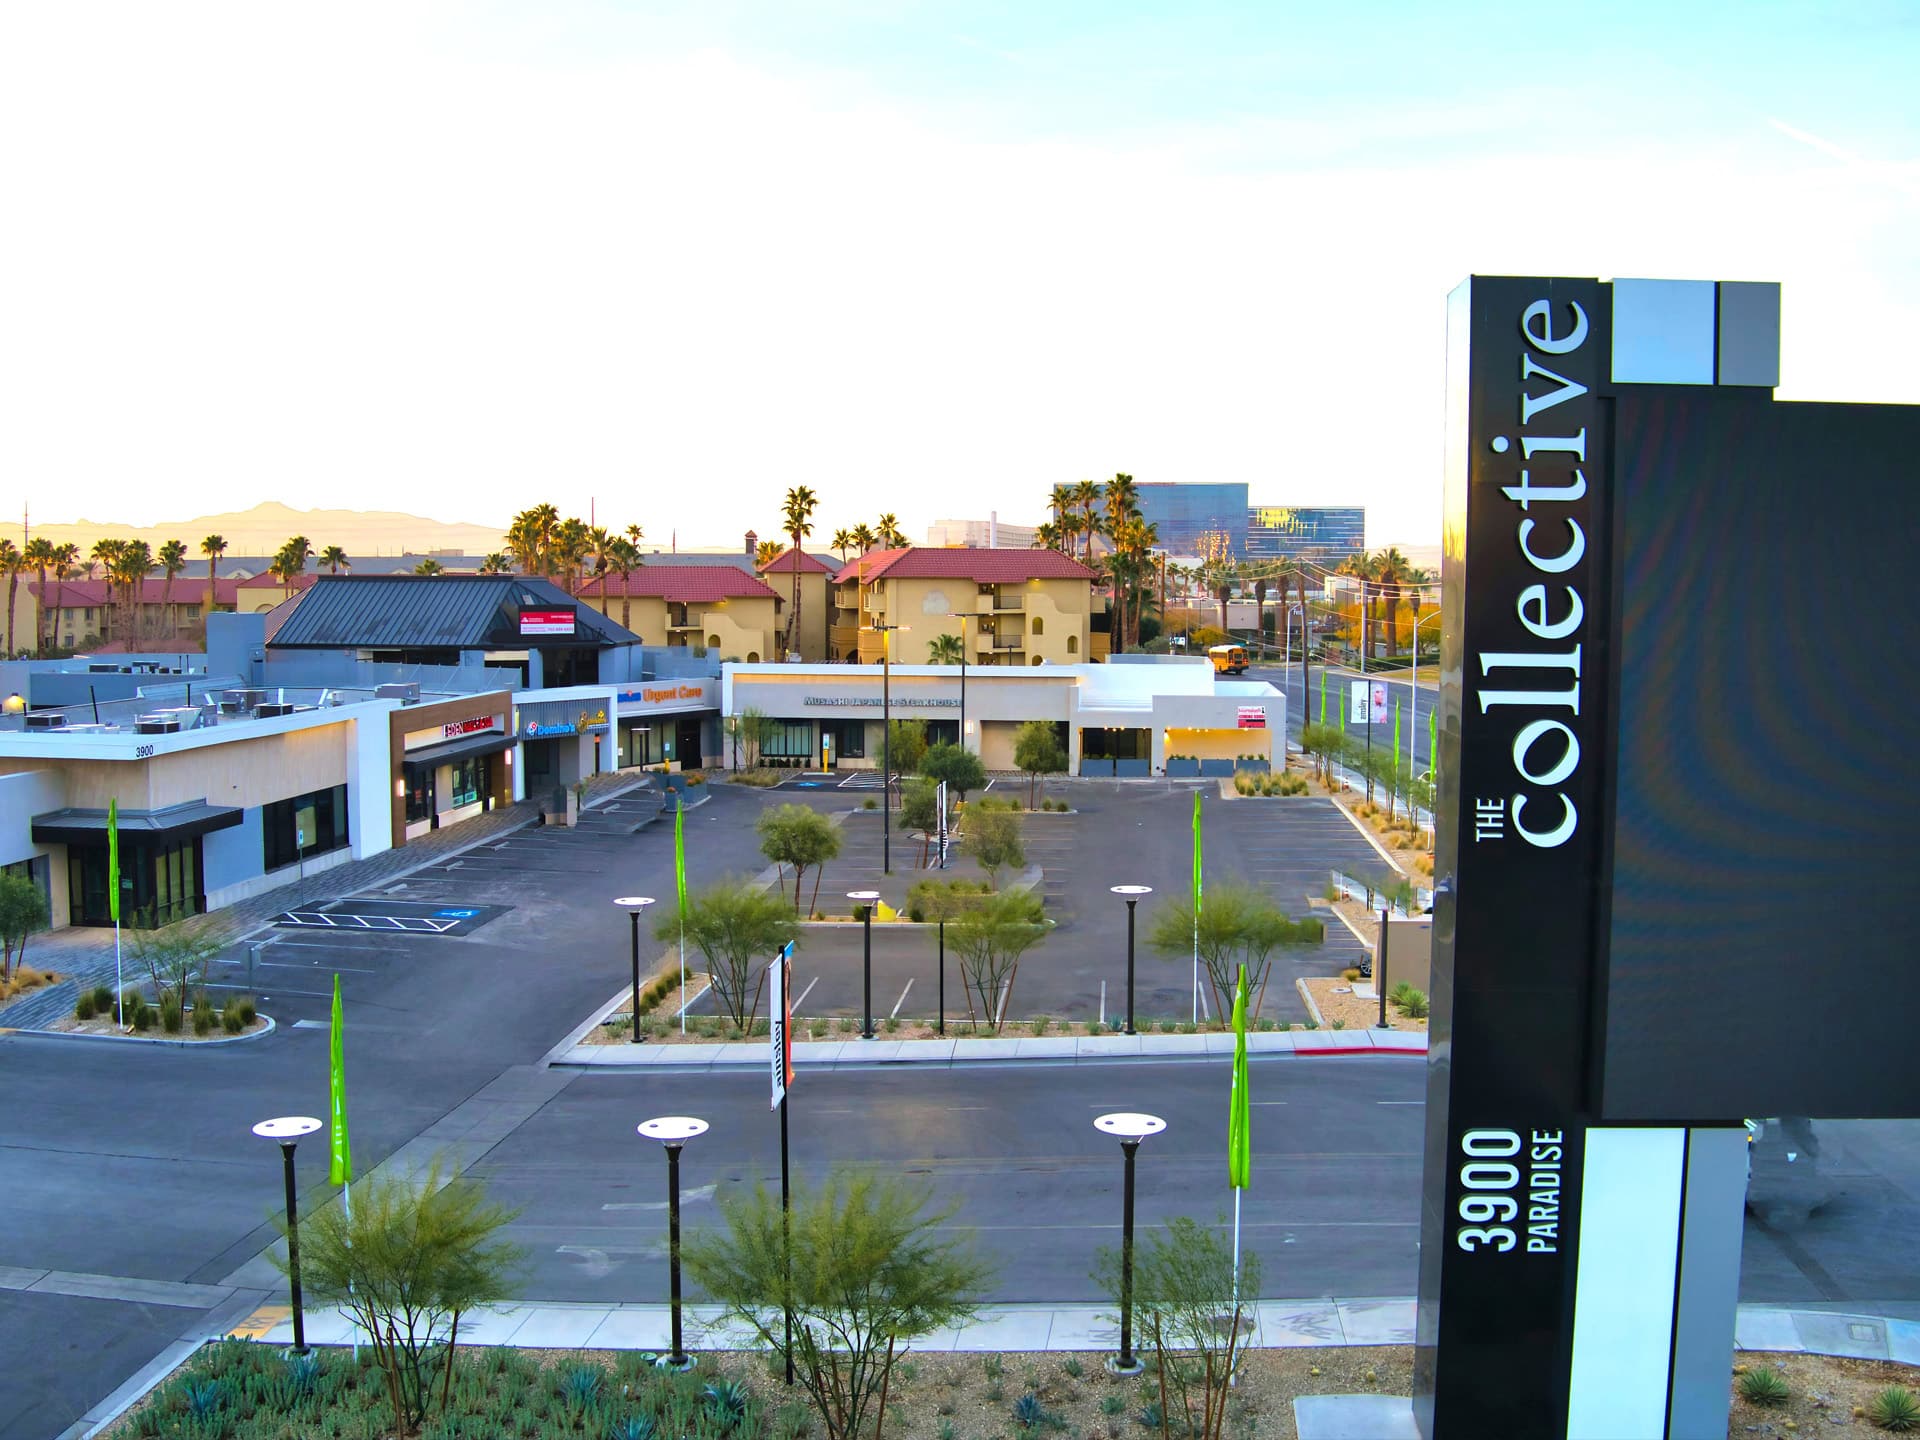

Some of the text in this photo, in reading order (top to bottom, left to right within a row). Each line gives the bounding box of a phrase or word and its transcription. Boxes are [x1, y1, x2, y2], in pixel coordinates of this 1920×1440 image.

[1477, 299, 1590, 848] collective
[642, 688, 677, 704] Urgent
[679, 685, 702, 699] Care
[803, 696, 848, 706] MUSASHI
[537, 722, 575, 736] Domino's
[136, 744, 154, 758] 3900
[1476, 798, 1504, 842] THE
[1457, 1128, 1521, 1252] 3900
[1527, 1128, 1562, 1252] PARADISE
